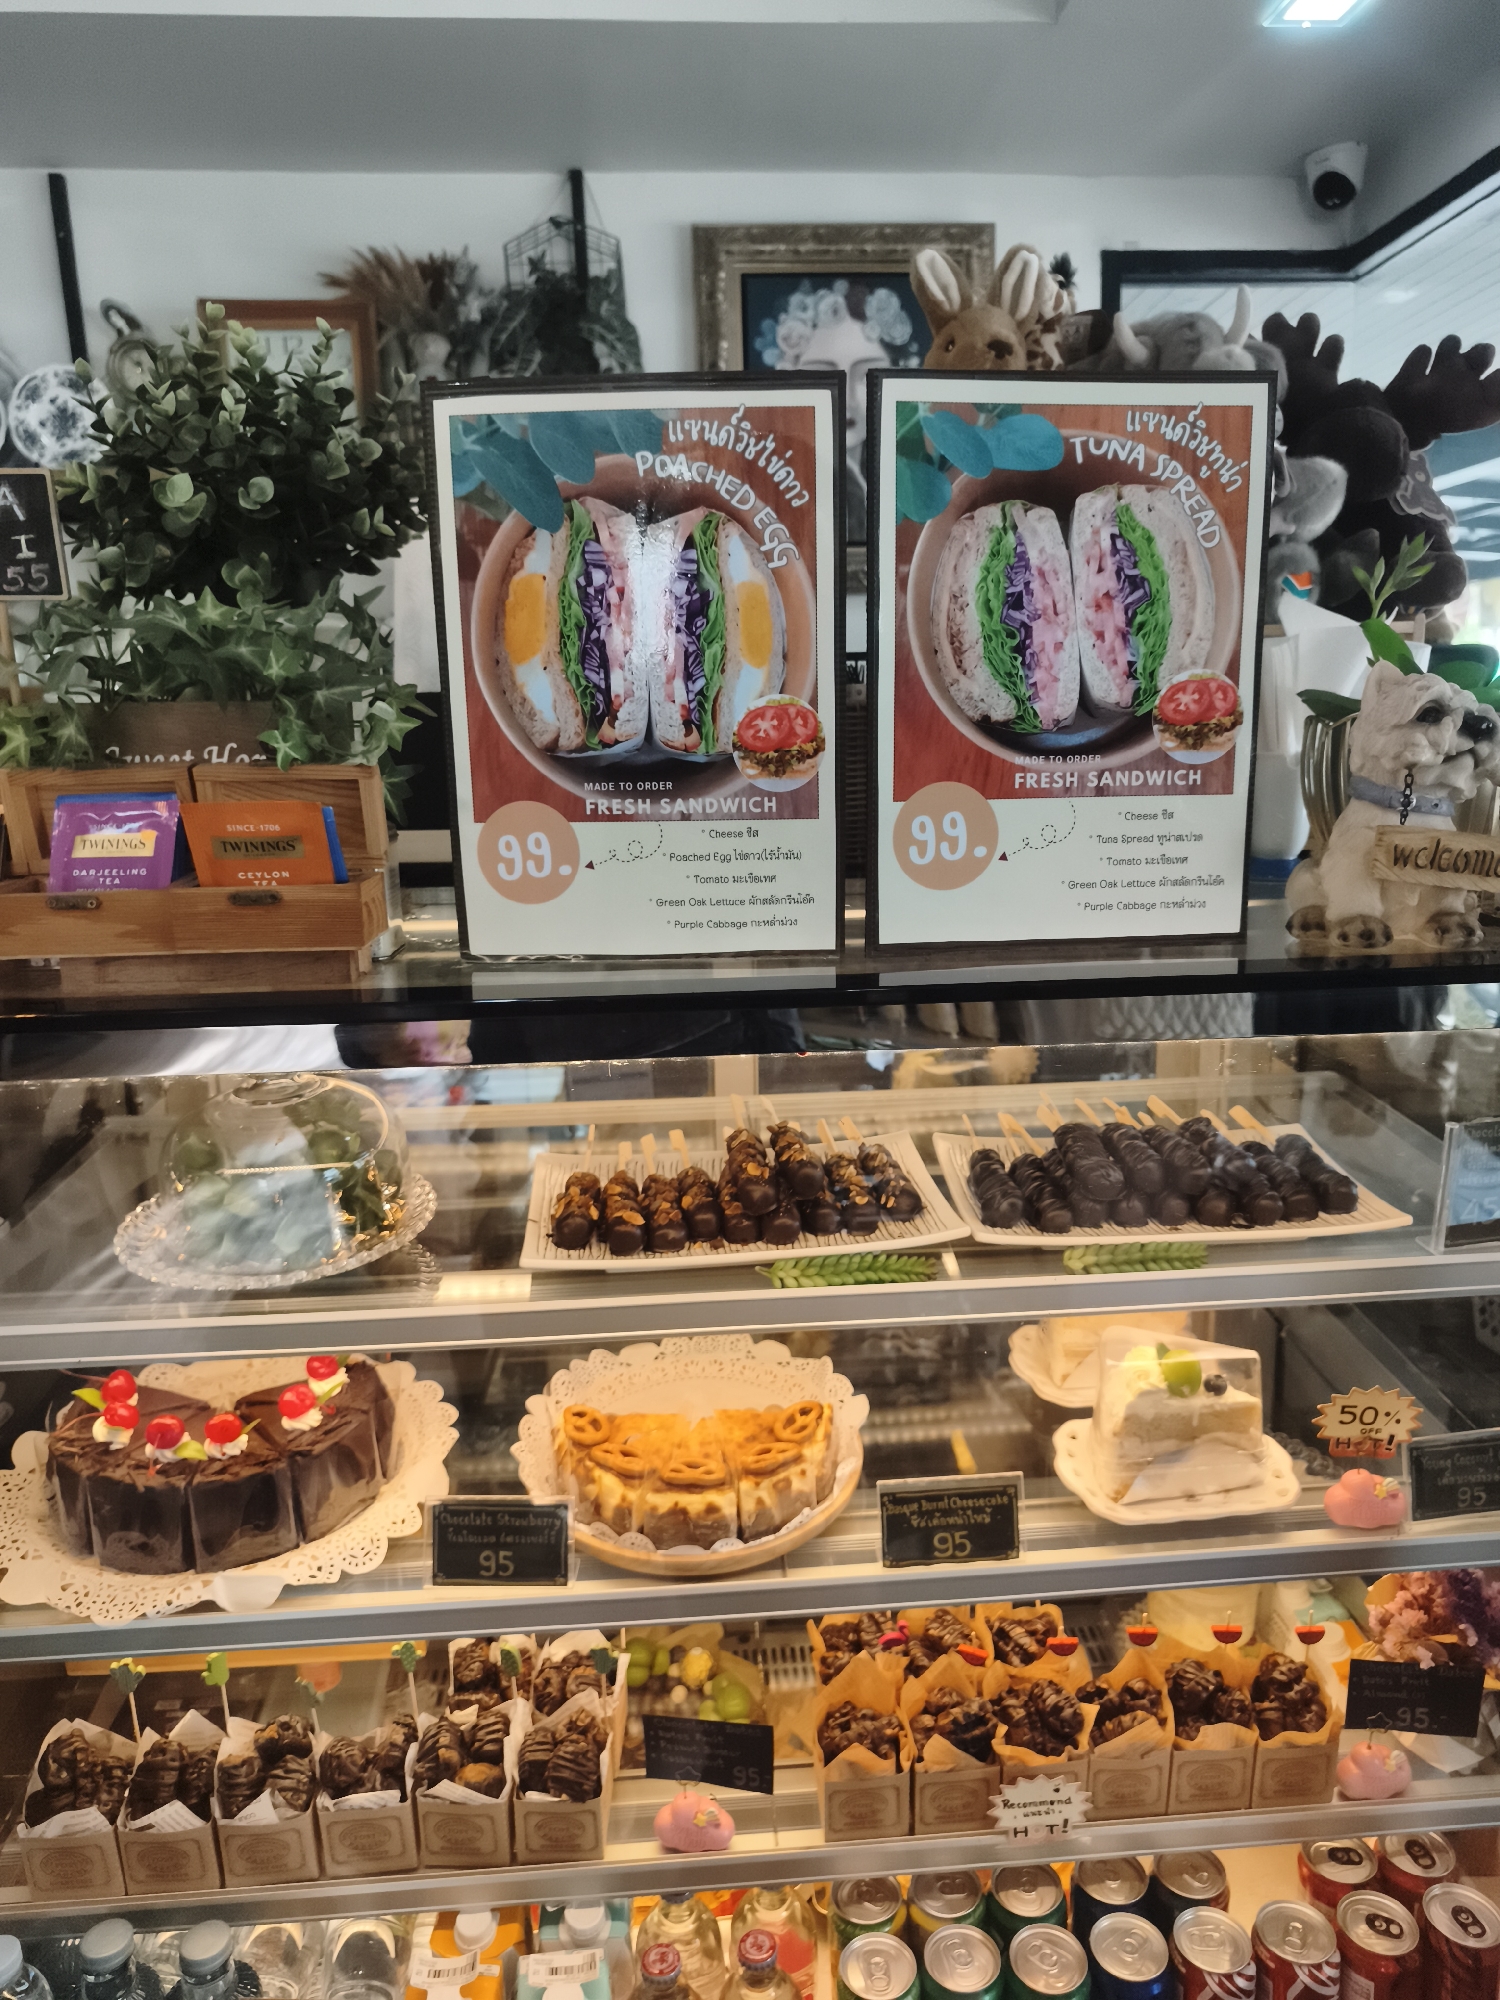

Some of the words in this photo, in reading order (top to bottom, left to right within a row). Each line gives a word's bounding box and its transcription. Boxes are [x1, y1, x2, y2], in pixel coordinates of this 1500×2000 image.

[1126, 401, 1249, 493] แซนด์วิชทูน่า
[668, 403, 810, 507] แซนด์วิชไข่ดาว
[1069, 436, 1146, 472] TUNA
[1149, 453, 1221, 549] SPREAD
[635, 450, 757, 511] POACHED
[753, 506, 800, 569] EGG
[1014, 755, 1045, 765] MADE
[1049, 755, 1063, 764] TO
[1066, 754, 1101, 764] ORDER
[1014, 771, 1078, 789] FRESH
[1086, 769, 1202, 787] SANDWICH
[584, 782, 615, 791] MADE
[619, 782, 633, 791] TO
[636, 781, 673, 791] ORDER
[585, 798, 651, 815] FRESH
[660, 796, 777, 815] SANDWICH
[1124, 811, 1158, 821] Cheese
[708, 829, 744, 839] Cheese
[908, 810, 988, 865] 99.
[1096, 834, 1118, 844] Tuna
[1121, 834, 1154, 845] Spread
[81, 838, 147, 850] TWININGS
[220, 840, 297, 853] TWININGS
[497, 831, 572, 881] 99.
[669, 852, 711, 862] Poached
[713, 852, 732, 863] Egg
[1106, 857, 1142, 866] Tomato
[72, 867, 147, 876] DARJEELING
[238, 871, 290, 879] CEYLON
[99, 877, 121, 885] TEA
[693, 874, 730, 884] Tomato
[1067, 880, 1097, 889] Green
[1099, 879, 1118, 889] Oak
[1121, 879, 1156, 888] Lettuce
[655, 898, 686, 907] Green
[688, 897, 707, 907] Oak
[709, 897, 746, 906] Lettuce
[1083, 902, 1114, 912] Purple
[1116, 901, 1157, 912] Cabbage
[674, 920, 704, 931] Purple
[706, 919, 748, 931] Cabbage
[1338, 1404, 1401, 1427] 50%
[1360, 1427, 1383, 1435] OFF
[1457, 1486, 1487, 1508] 95
[933, 1530, 972, 1558] 95
[479, 1550, 515, 1577] 95
